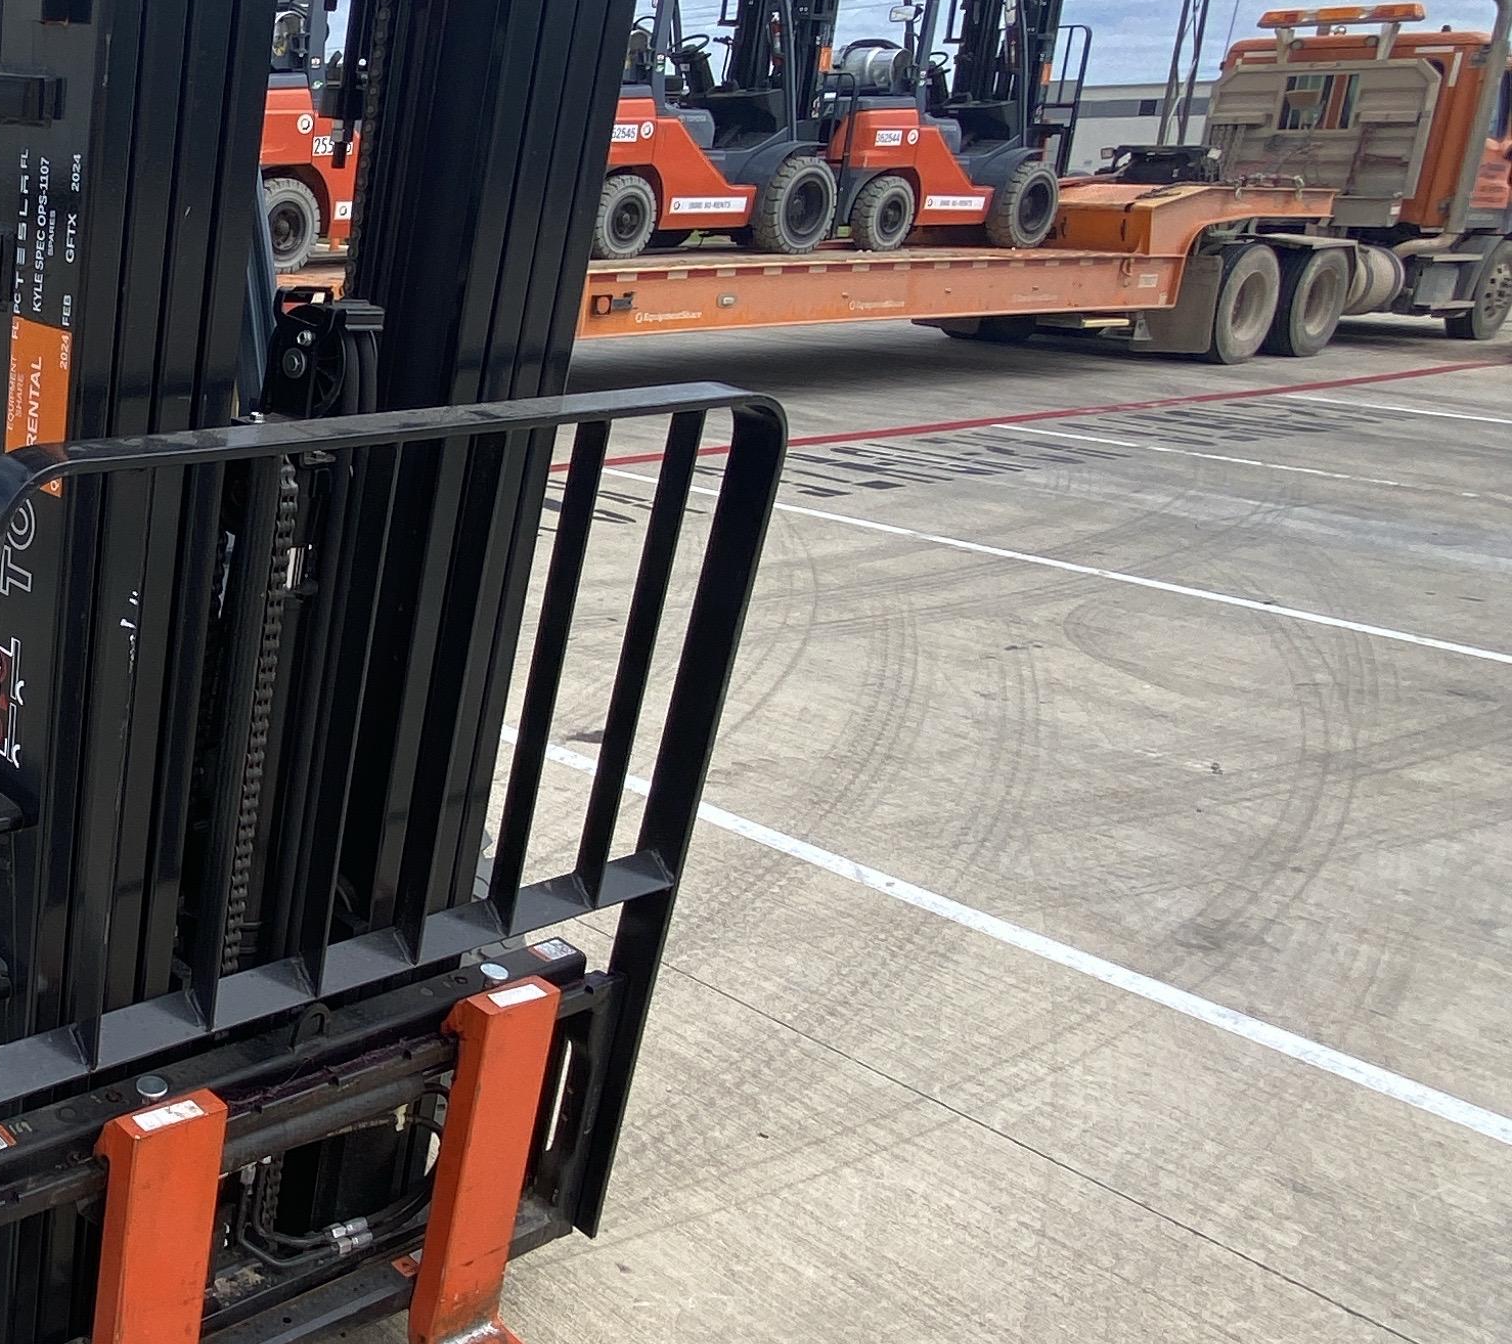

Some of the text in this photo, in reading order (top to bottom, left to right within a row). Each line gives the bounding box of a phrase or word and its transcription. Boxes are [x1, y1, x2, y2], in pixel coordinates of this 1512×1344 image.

[13, 148, 30, 315] PC TESLA FL
[32, 156, 50, 313] KYLE SPEC OPS-1107
[61, 153, 82, 327] FEB GFTX 2024
[7, 356, 18, 432] EQUIPMENT
[25, 355, 44, 447] RENTAL
[59, 334, 71, 370] 2024
[0, 497, 38, 597] TO
